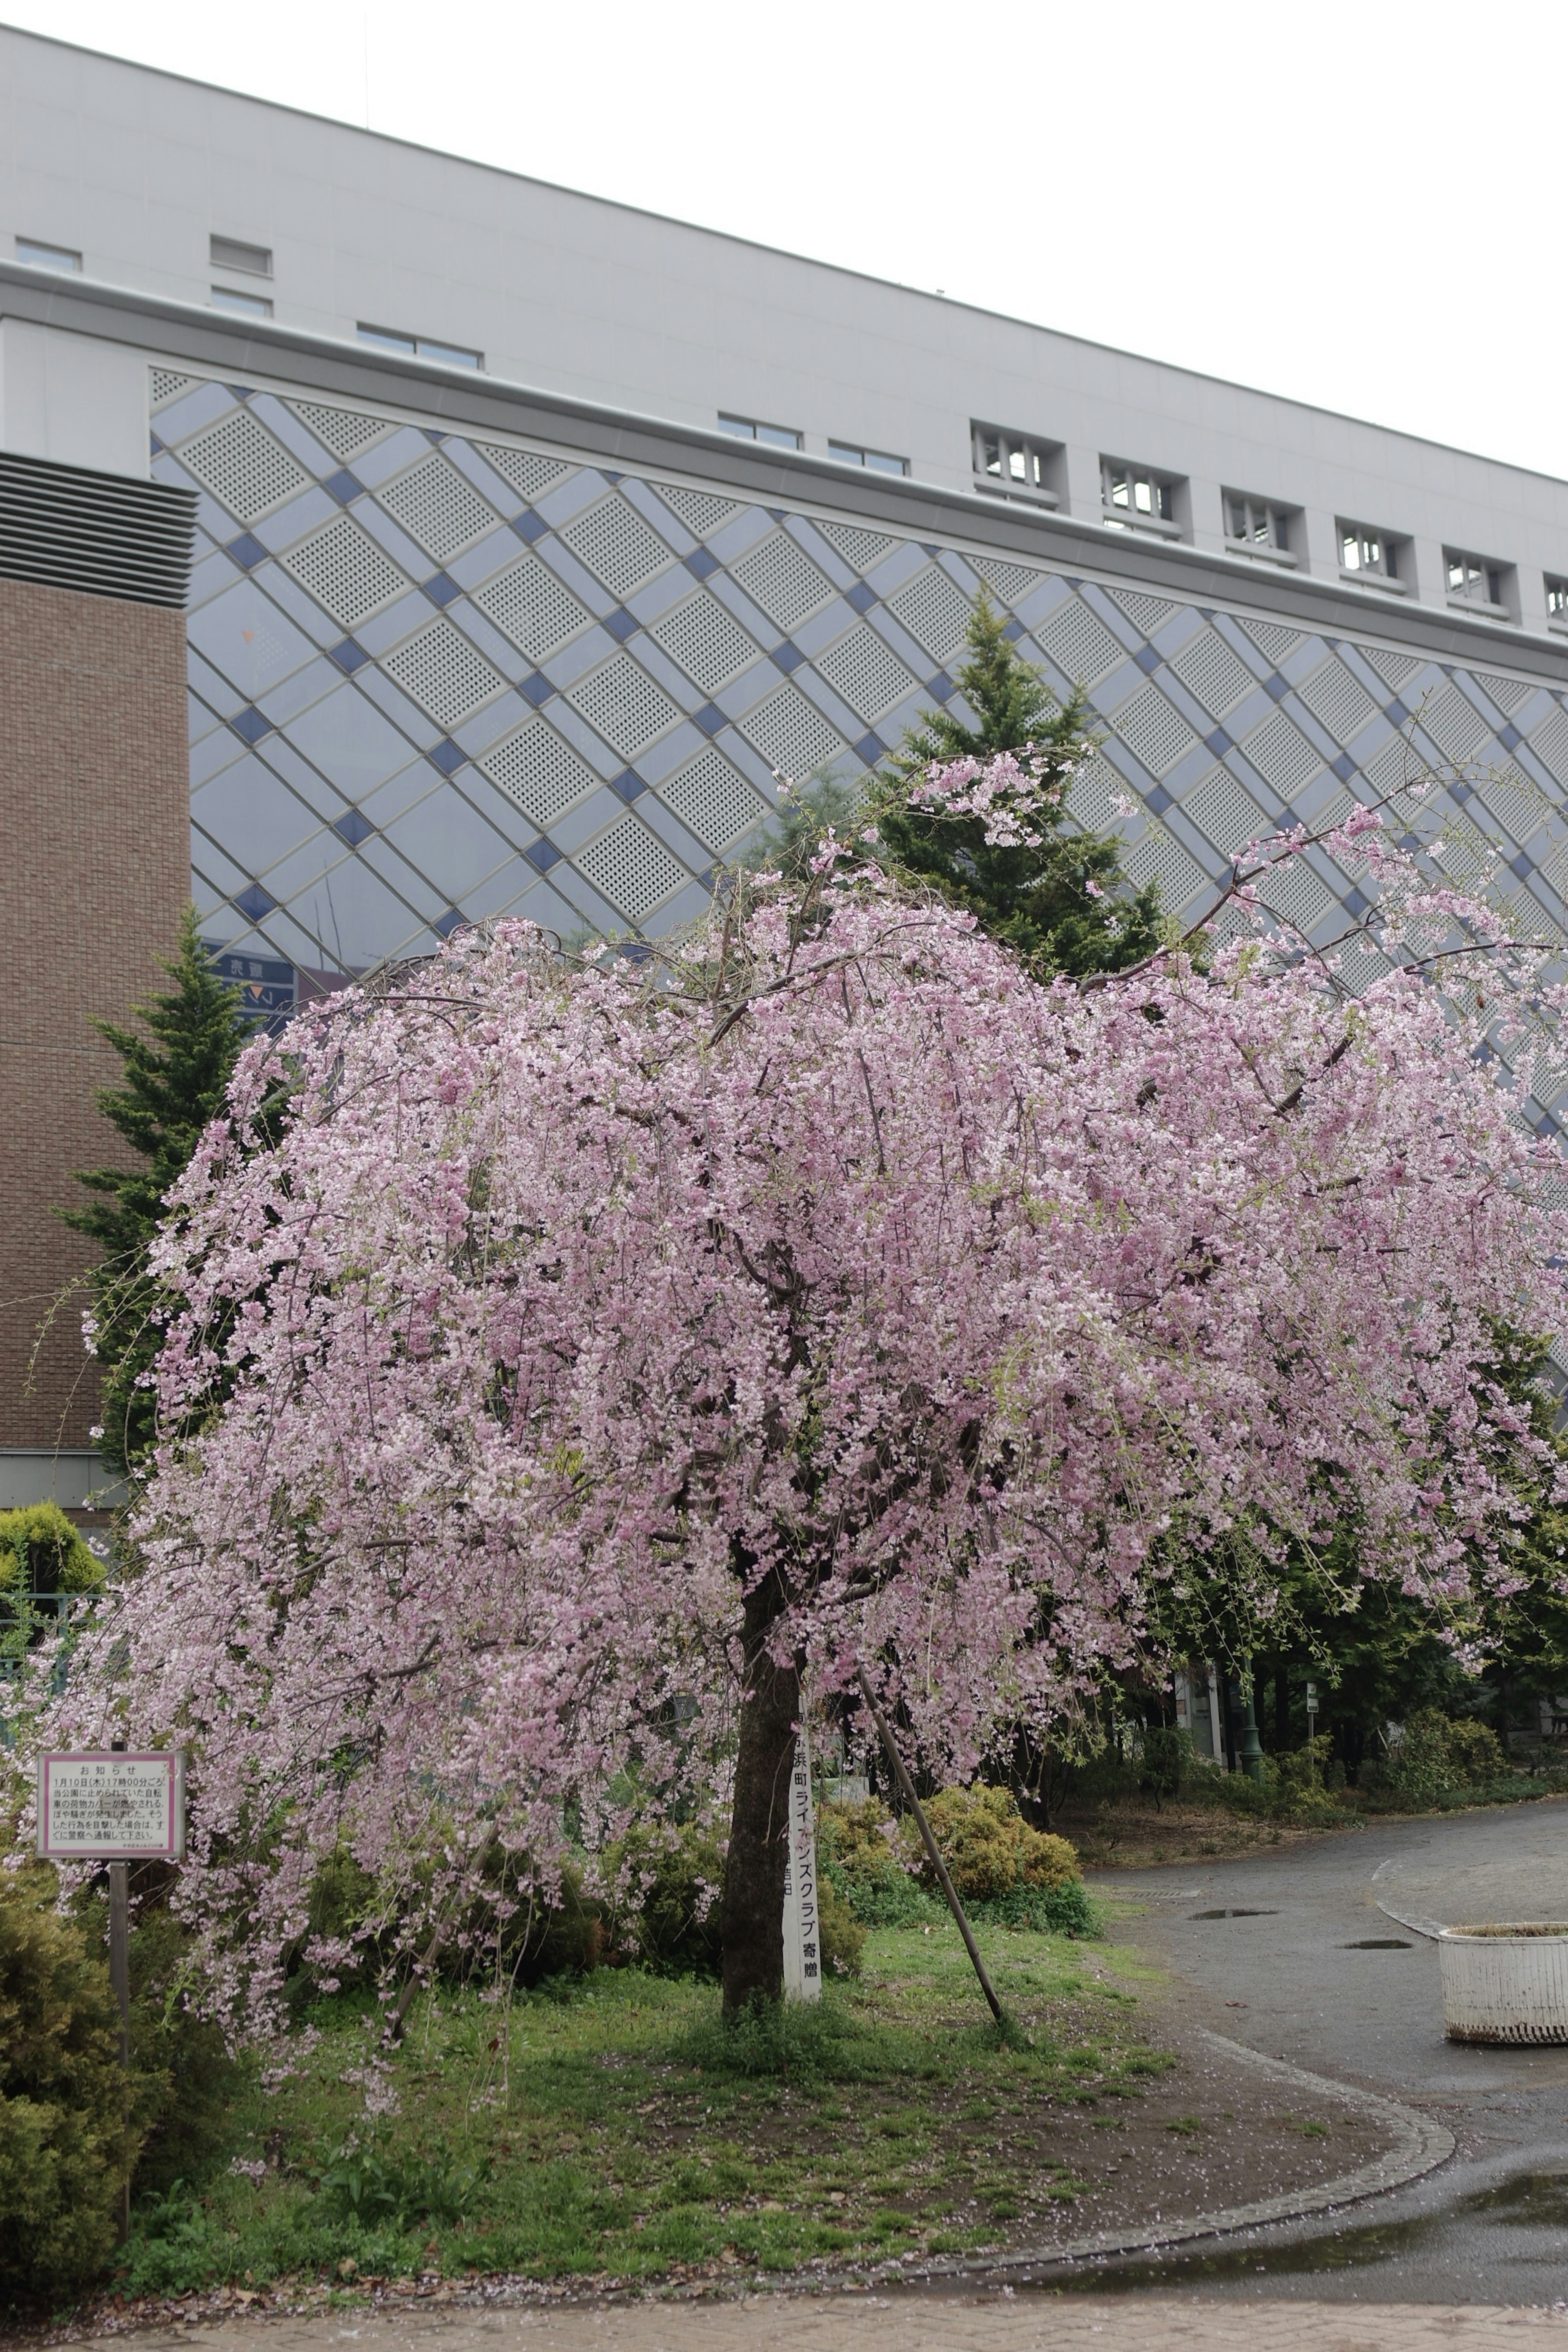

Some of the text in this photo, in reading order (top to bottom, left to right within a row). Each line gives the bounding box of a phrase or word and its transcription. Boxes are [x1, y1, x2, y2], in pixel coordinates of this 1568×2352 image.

[80, 1766, 136, 1775] お知らせ
[53, 1789, 162, 1797] 当公園に止められていた自転
[53, 1810, 162, 1818] ぼや騒ぎが発生しました。そう
[53, 1831, 153, 1840] ぐに警察へ通報して下さい。
